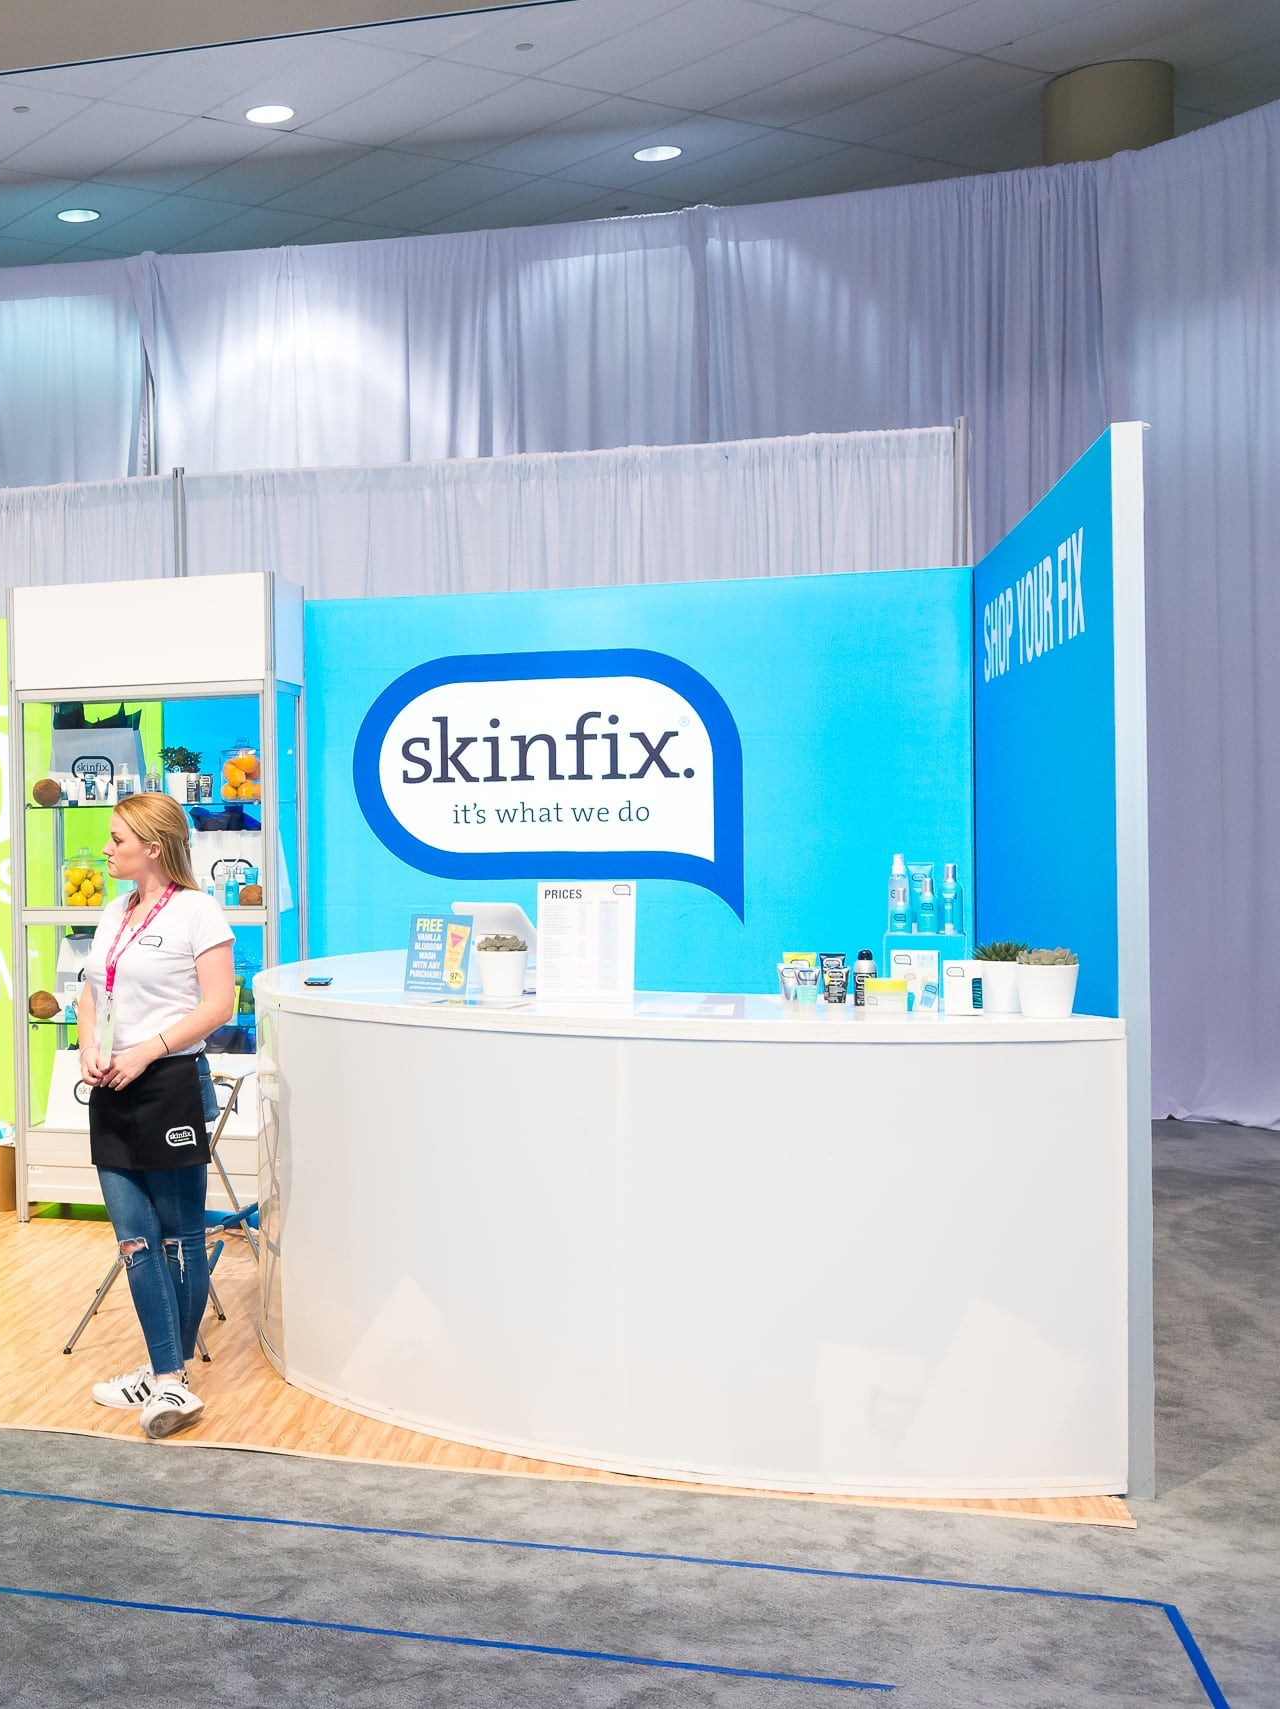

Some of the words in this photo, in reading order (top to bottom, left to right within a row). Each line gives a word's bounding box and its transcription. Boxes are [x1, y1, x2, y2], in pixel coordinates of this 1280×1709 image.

[983, 587, 1014, 683] SHOP
[1016, 555, 1054, 665] YOUR
[1057, 526, 1085, 645] FIX
[401, 711, 695, 784] skinfix.
[495, 801, 564, 824] what
[570, 805, 610, 823] we
[618, 801, 650, 823] do
[544, 889, 583, 900] PRICES
[416, 918, 444, 932] FREE
[417, 933, 442, 941] VANILLA
[414, 942, 443, 951] BLOSSOM
[418, 951, 437, 960] WASH
[412, 960, 428, 969] WITH
[428, 961, 441, 970] ANY
